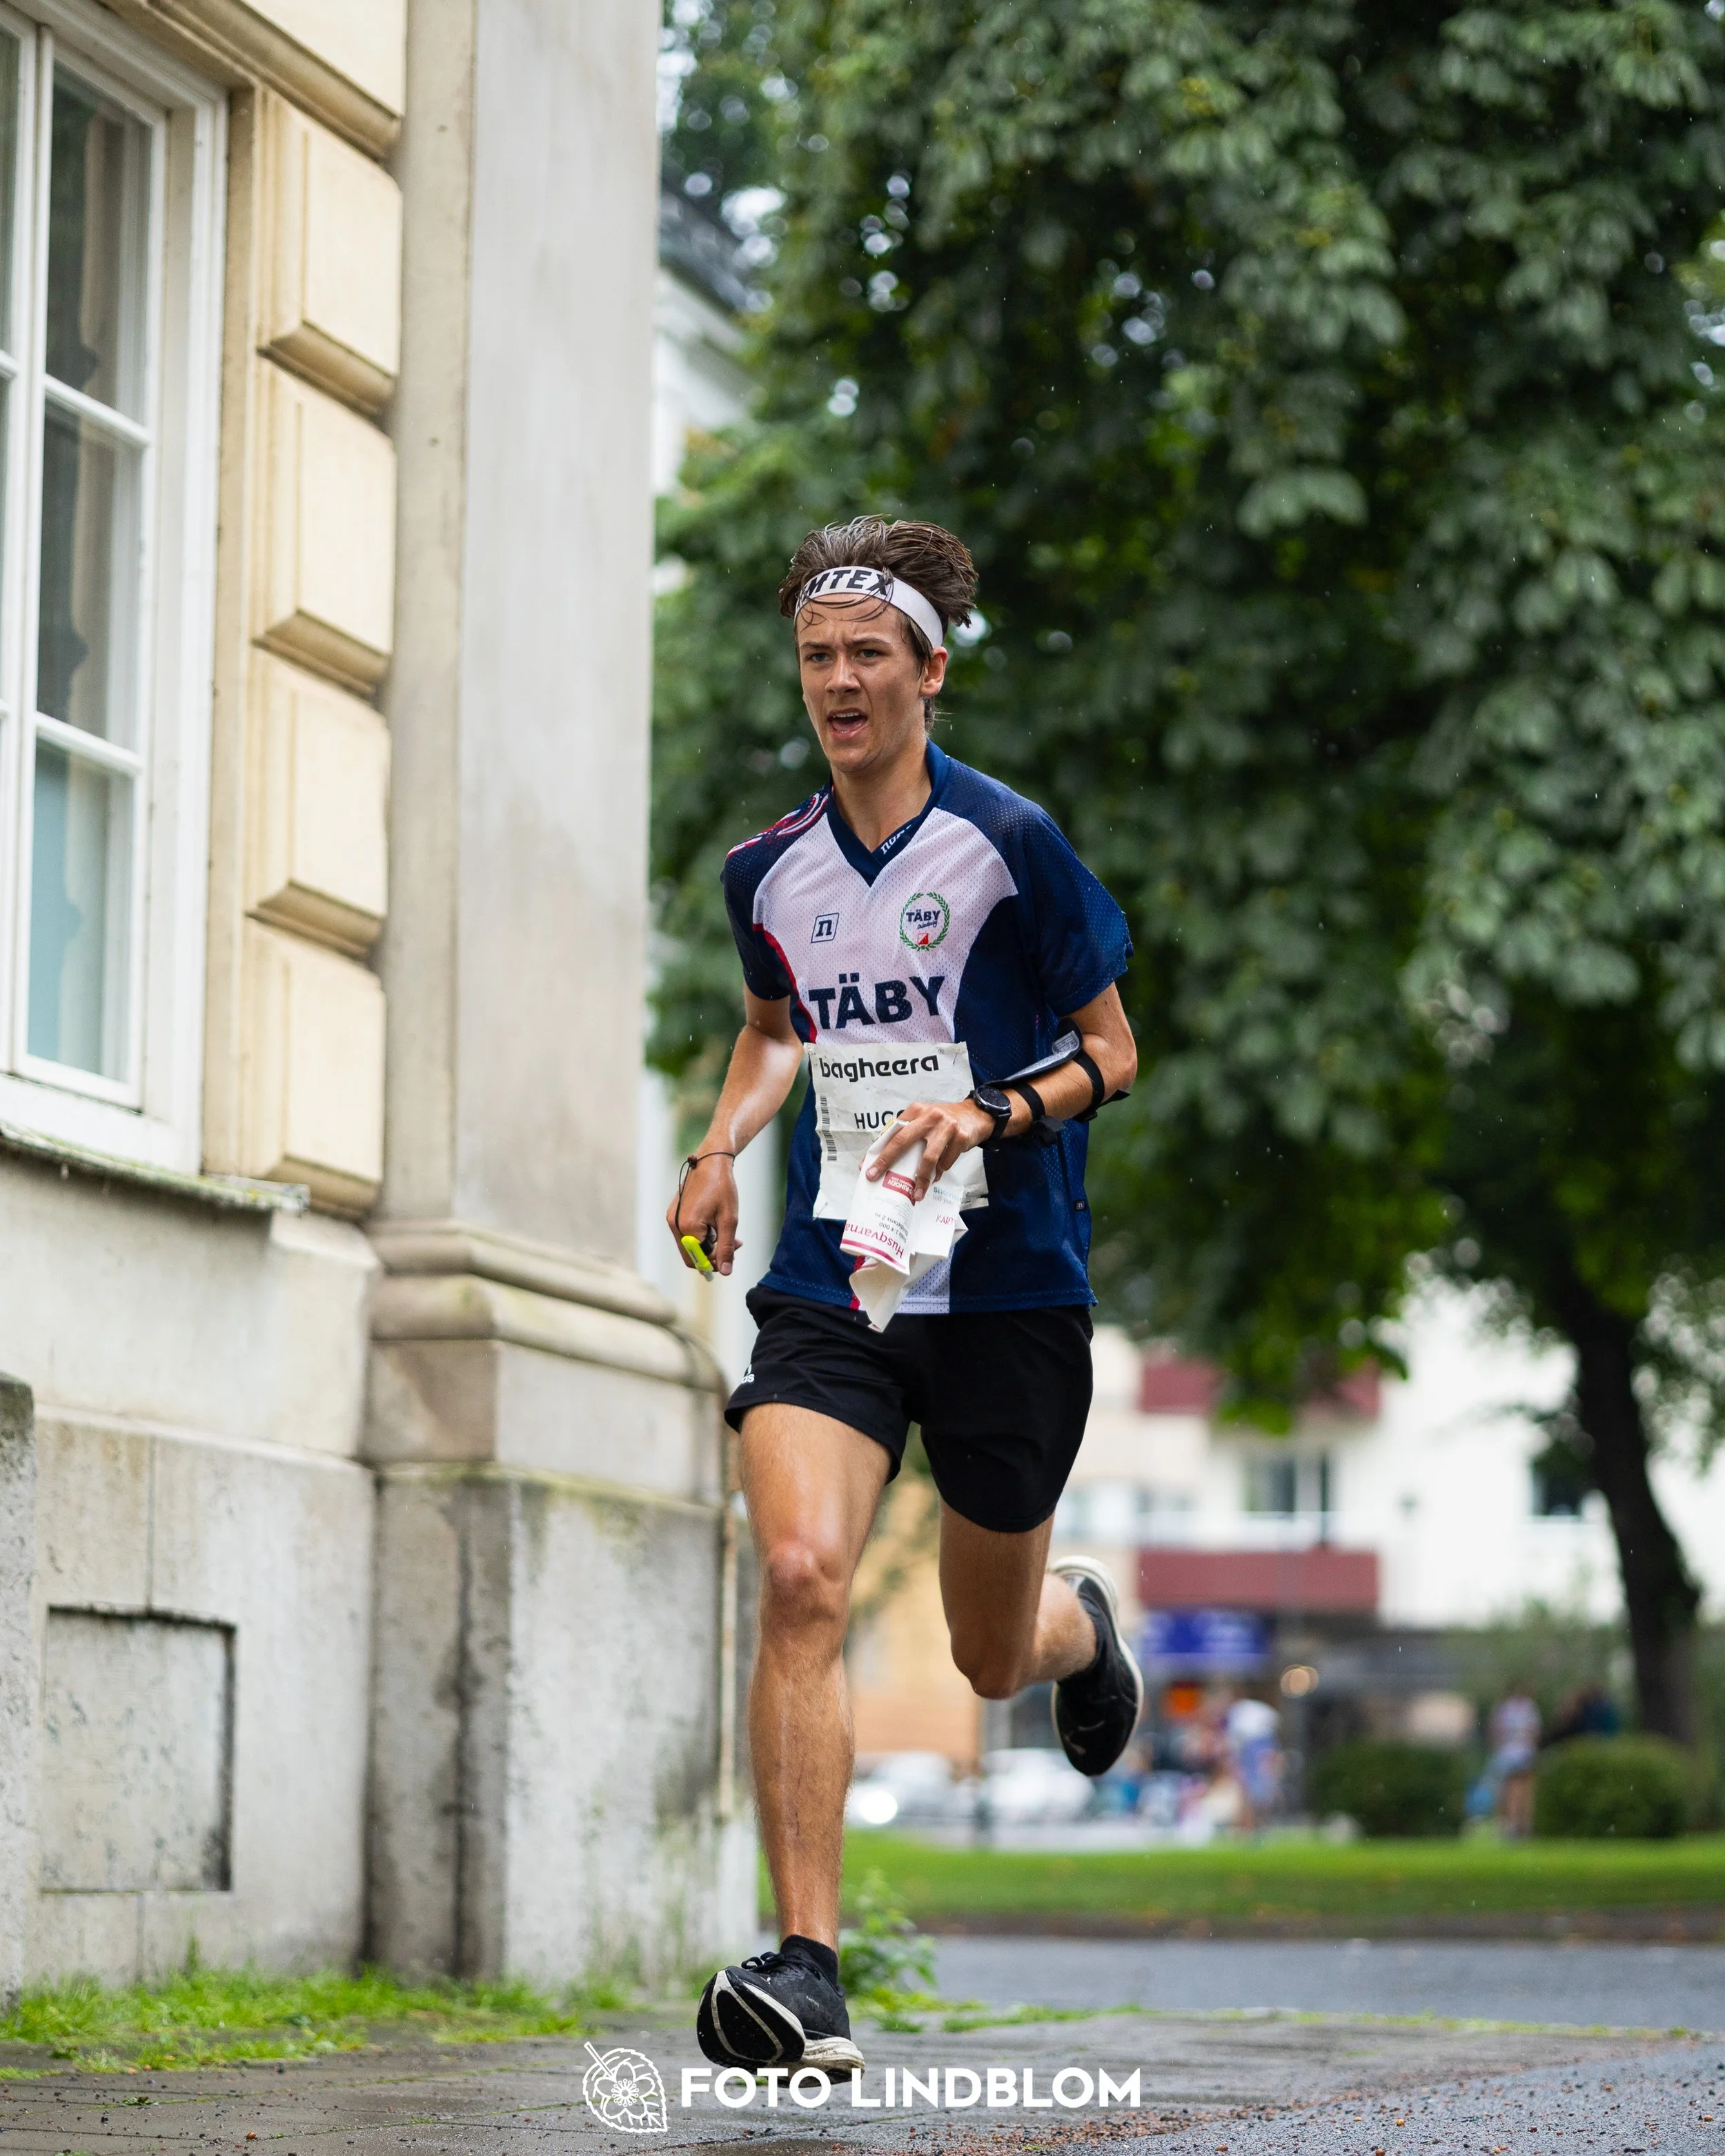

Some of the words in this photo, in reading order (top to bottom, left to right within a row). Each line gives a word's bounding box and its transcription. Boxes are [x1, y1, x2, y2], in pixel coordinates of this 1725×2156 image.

[905, 909, 941, 922] TÄBY
[808, 972, 945, 1029] TÄBY
[819, 1055, 939, 1082] bagheera
[845, 1223, 904, 1259] Husqvarna
